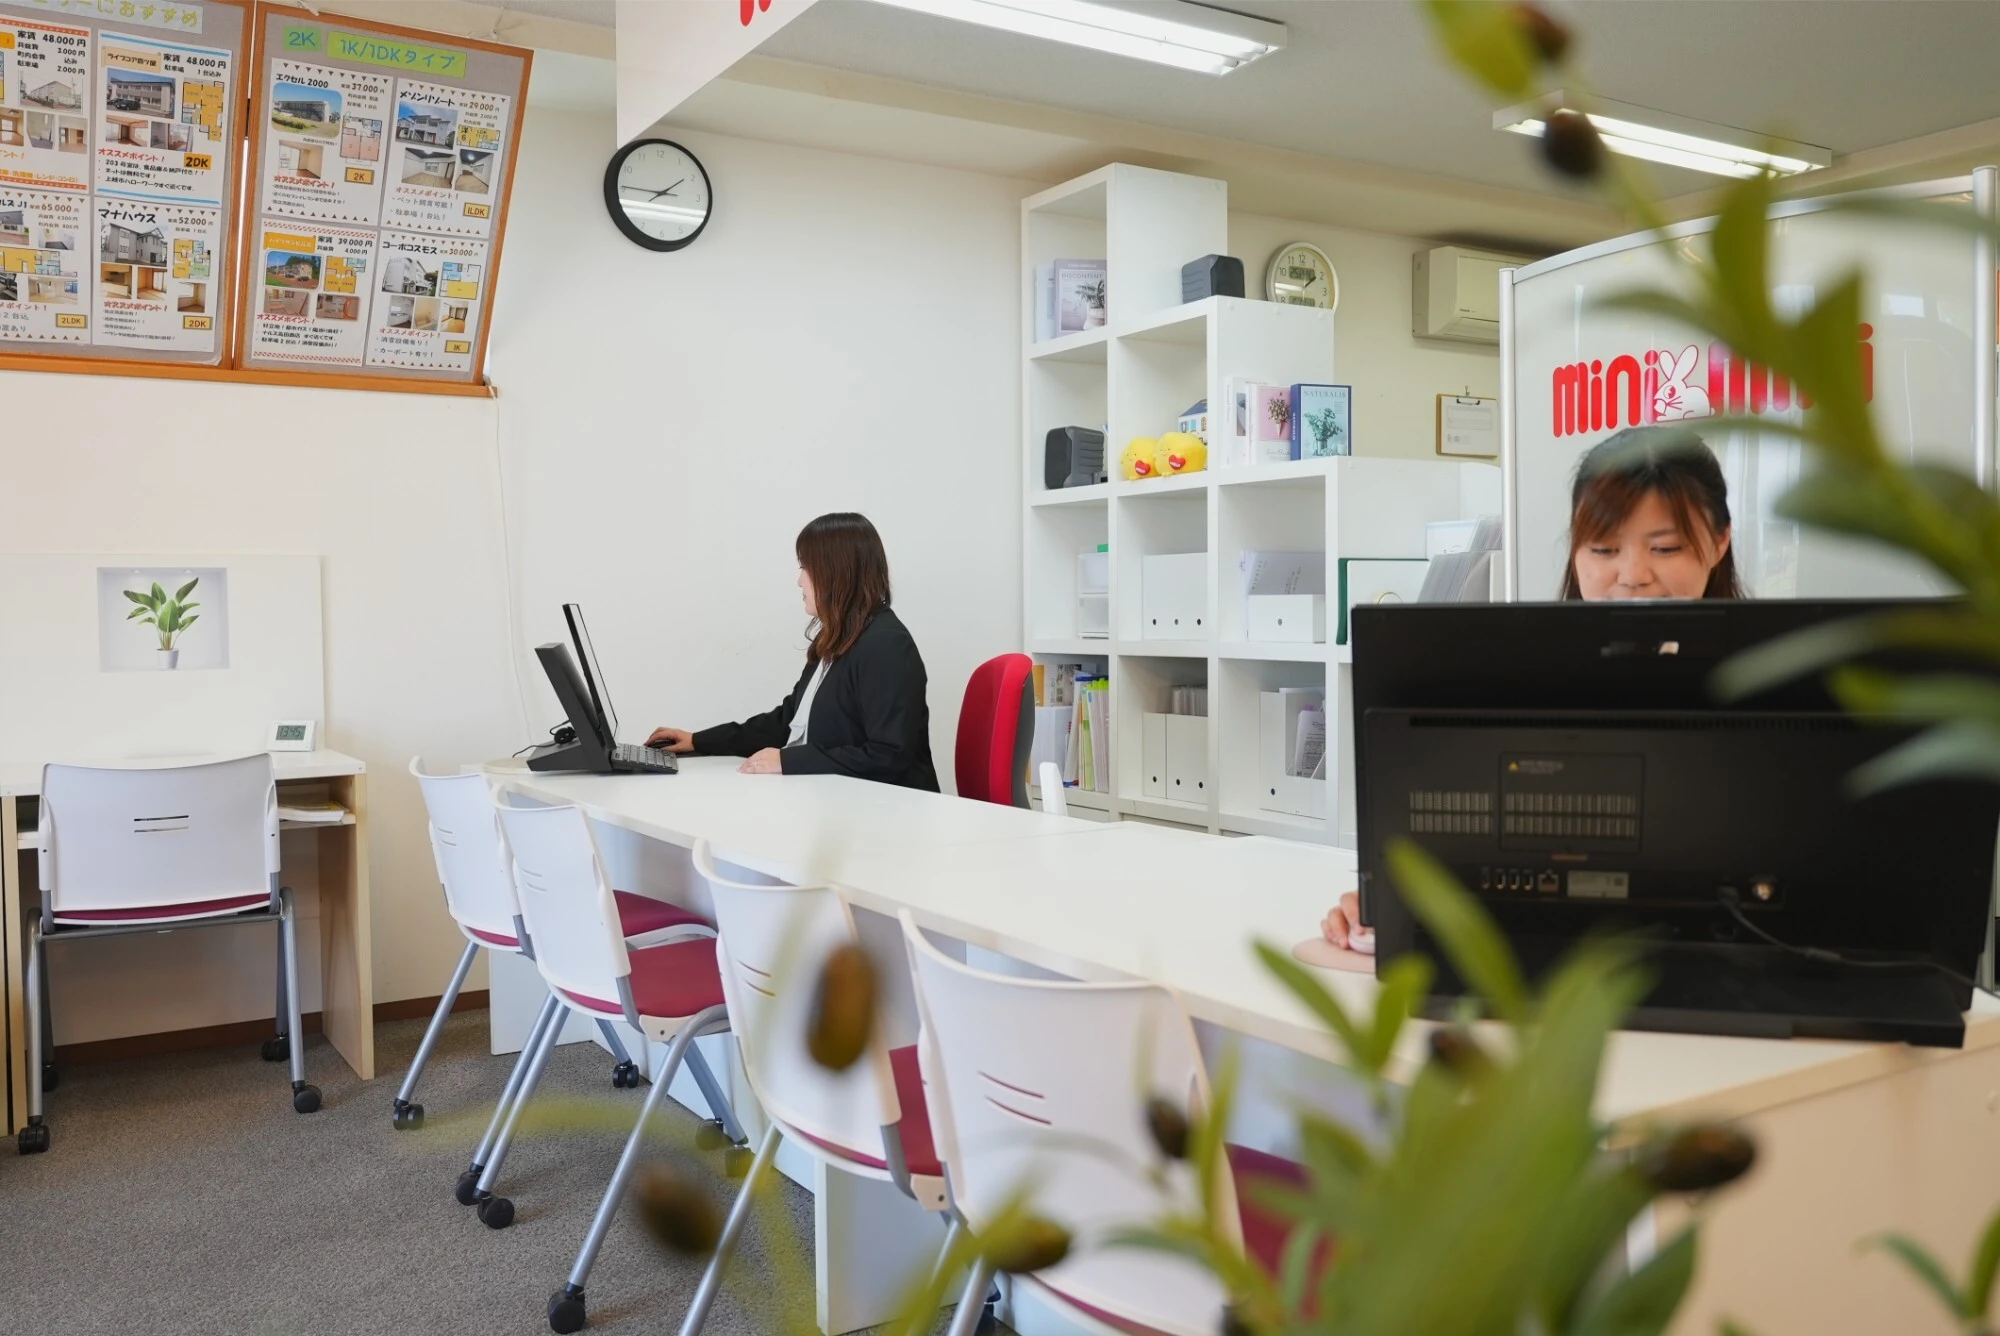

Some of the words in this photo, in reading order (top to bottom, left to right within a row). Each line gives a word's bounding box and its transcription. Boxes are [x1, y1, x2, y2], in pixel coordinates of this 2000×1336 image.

[17, 30, 36, 40] 家賃
[288, 31, 316, 46] 2K
[638, 153, 646, 162] 11
[656, 149, 665, 159] 12
[185, 157, 209, 168] 2DK
[624, 165, 633, 175] 10
[353, 172, 365, 181] 2K
[98, 208, 157, 225] マナハウス
[382, 240, 438, 256] コーポコスモス
[1298, 254, 1306, 264] 12
[1279, 267, 1287, 277] 10
[61, 317, 81, 325] 2LDK
[188, 319, 207, 328] 2DK
[1303, 390, 1346, 399] NATURALIS
[1553, 349, 1658, 438] mini
